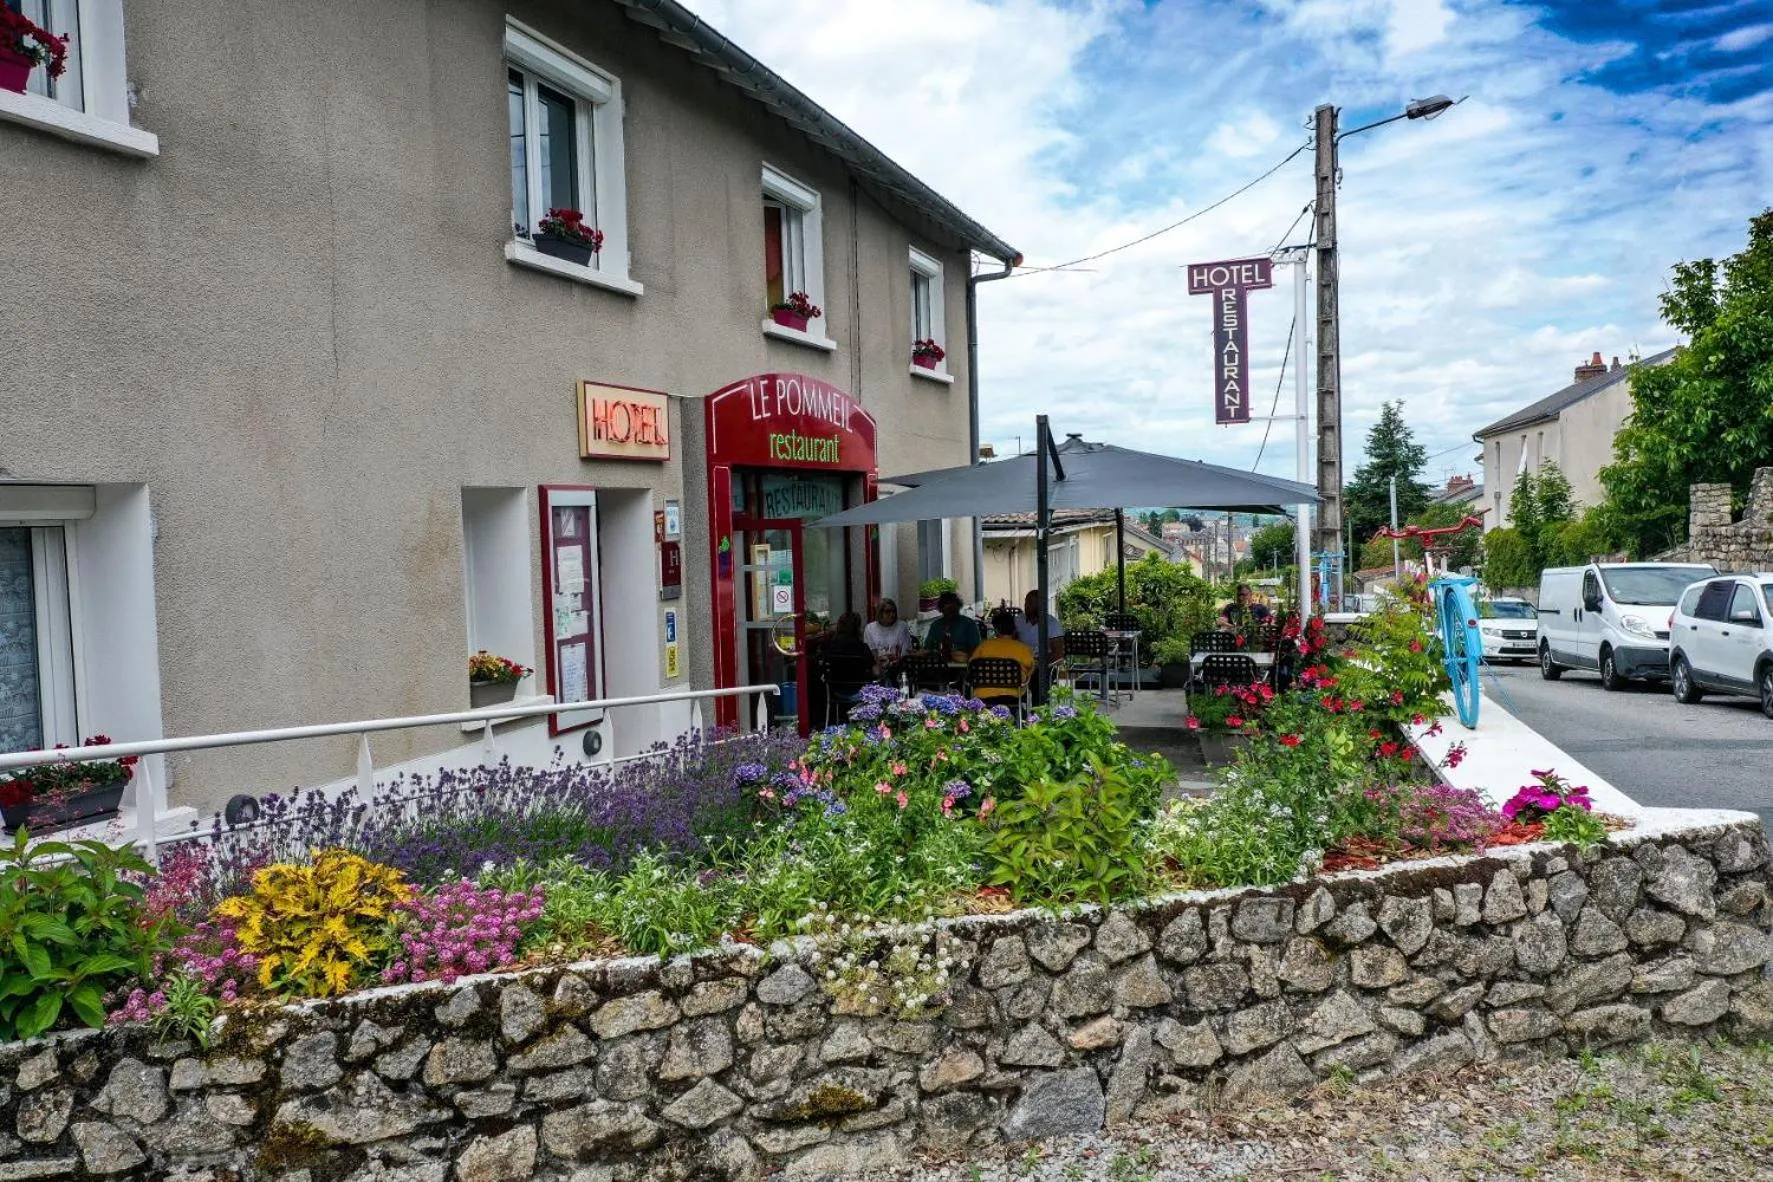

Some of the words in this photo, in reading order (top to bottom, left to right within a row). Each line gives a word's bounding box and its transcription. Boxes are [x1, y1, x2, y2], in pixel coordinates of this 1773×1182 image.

[1193, 264, 1265, 287] HOTEL
[1222, 289, 1240, 418] RESTAURANT
[592, 398, 667, 445] HOTEL
[750, 380, 771, 420] LE
[776, 379, 853, 433] POMMEIL
[770, 428, 839, 463] restaurant
